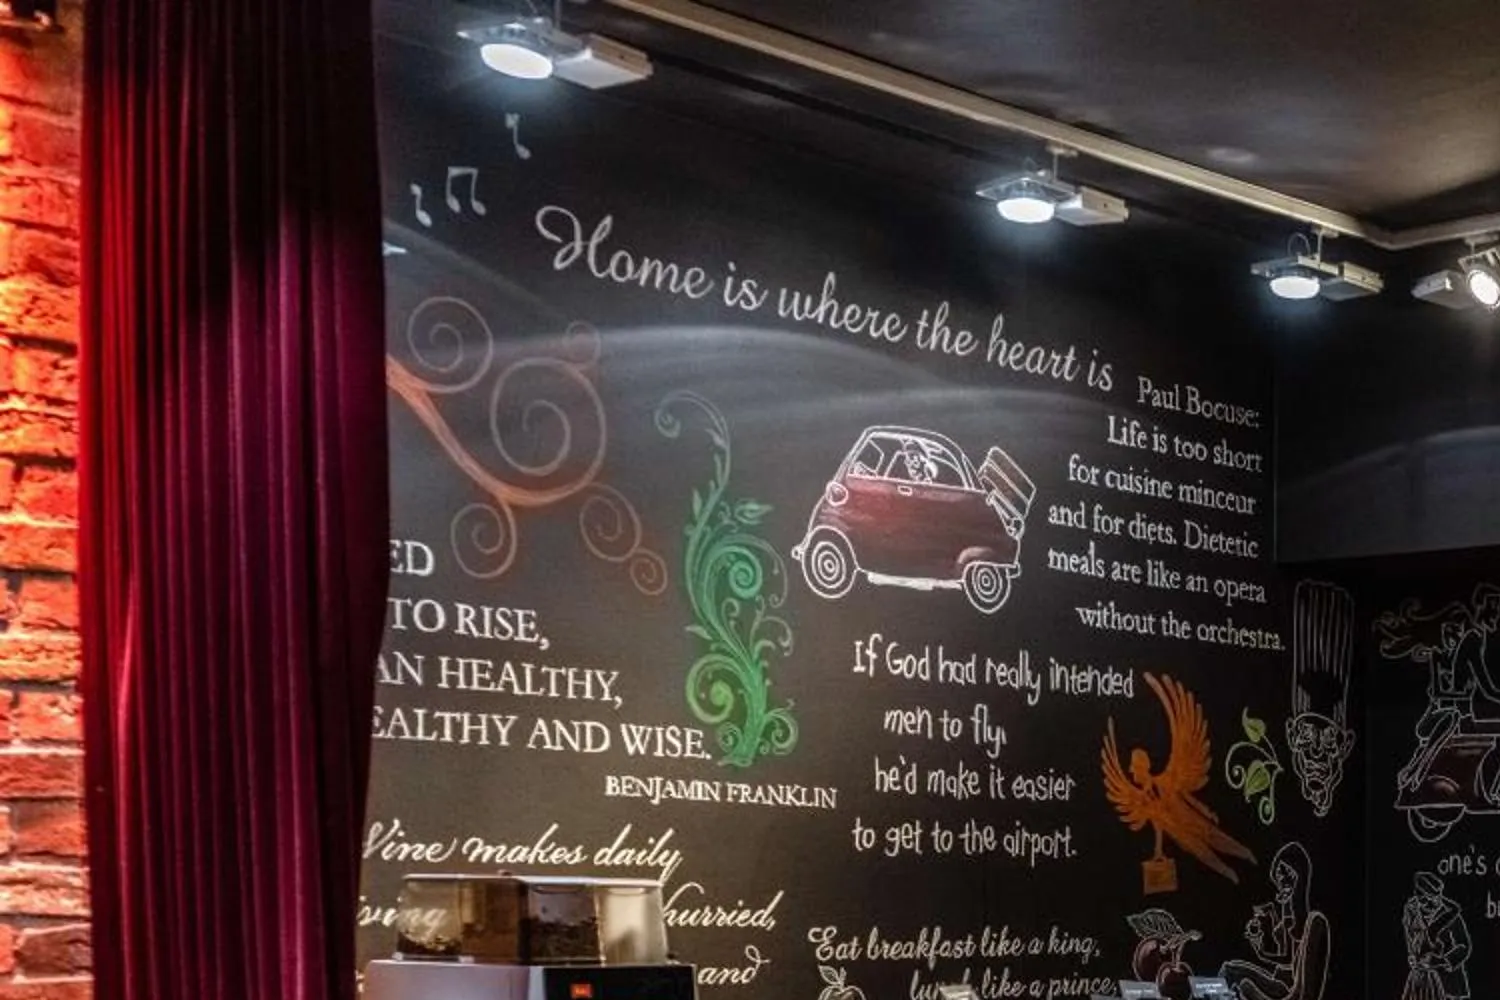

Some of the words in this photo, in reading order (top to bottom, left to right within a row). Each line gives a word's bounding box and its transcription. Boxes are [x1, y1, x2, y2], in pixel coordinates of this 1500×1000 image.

[535, 205, 713, 299] Home
[723, 260, 768, 311] is
[778, 272, 908, 342] where
[916, 301, 978, 356] the
[987, 314, 1080, 381] heart
[1088, 349, 1113, 391] is
[1137, 376, 1179, 411] Paul
[1186, 385, 1260, 428] Bocuse:
[1108, 416, 1148, 448] Life
[1153, 425, 1167, 452] is
[1174, 437, 1207, 463] too
[1213, 437, 1262, 473] short
[1069, 455, 1099, 486] for
[1106, 464, 1172, 500] cuisine
[1178, 474, 1256, 515] minceur
[1048, 502, 1086, 530] and
[1093, 506, 1124, 537] for
[1128, 512, 1177, 546] diets.
[1184, 520, 1258, 559] Dietetic
[389, 539, 434, 576] ED
[1048, 540, 1105, 578] meals
[1111, 559, 1141, 582] are
[1148, 559, 1180, 589] like
[1186, 574, 1208, 594] an
[1214, 579, 1267, 606] opera
[387, 597, 447, 633] TO
[455, 603, 550, 650] RISE,
[1076, 601, 1155, 635] without
[1161, 610, 1191, 640] the
[1197, 617, 1286, 651] orchestra.
[377, 651, 425, 686] AN
[438, 657, 623, 709] HEALTHY,
[853, 632, 884, 677] If
[885, 641, 930, 681] God
[938, 645, 977, 685] had
[985, 649, 1041, 706] really
[1049, 658, 1134, 698] intended
[371, 706, 517, 747] EALTHY
[526, 719, 610, 754] AND
[621, 724, 712, 760] WISE.
[883, 706, 933, 739] men
[938, 710, 963, 741] to
[605, 774, 721, 805] BENJAMIN
[726, 782, 837, 809] FRANKLIN
[874, 755, 917, 795] he'd
[927, 761, 981, 800] make
[989, 763, 1004, 800] it
[1012, 768, 1076, 801] easier
[462, 823, 588, 867] makes
[592, 822, 685, 884] daily
[852, 816, 876, 851] to
[885, 819, 923, 857] get
[931, 820, 953, 851] to
[959, 818, 997, 853] the
[1004, 820, 1078, 867] airport.
[1437, 844, 1488, 876] one's
[663, 882, 784, 931] hurried,
[698, 945, 771, 985] and
[808, 926, 862, 963] Eat
[866, 925, 976, 969] breakfast
[980, 925, 1026, 957] like
[1028, 938, 1044, 957] a
[1048, 925, 1101, 966] king,
[981, 967, 1026, 999] like
[1029, 978, 1044, 996] a
